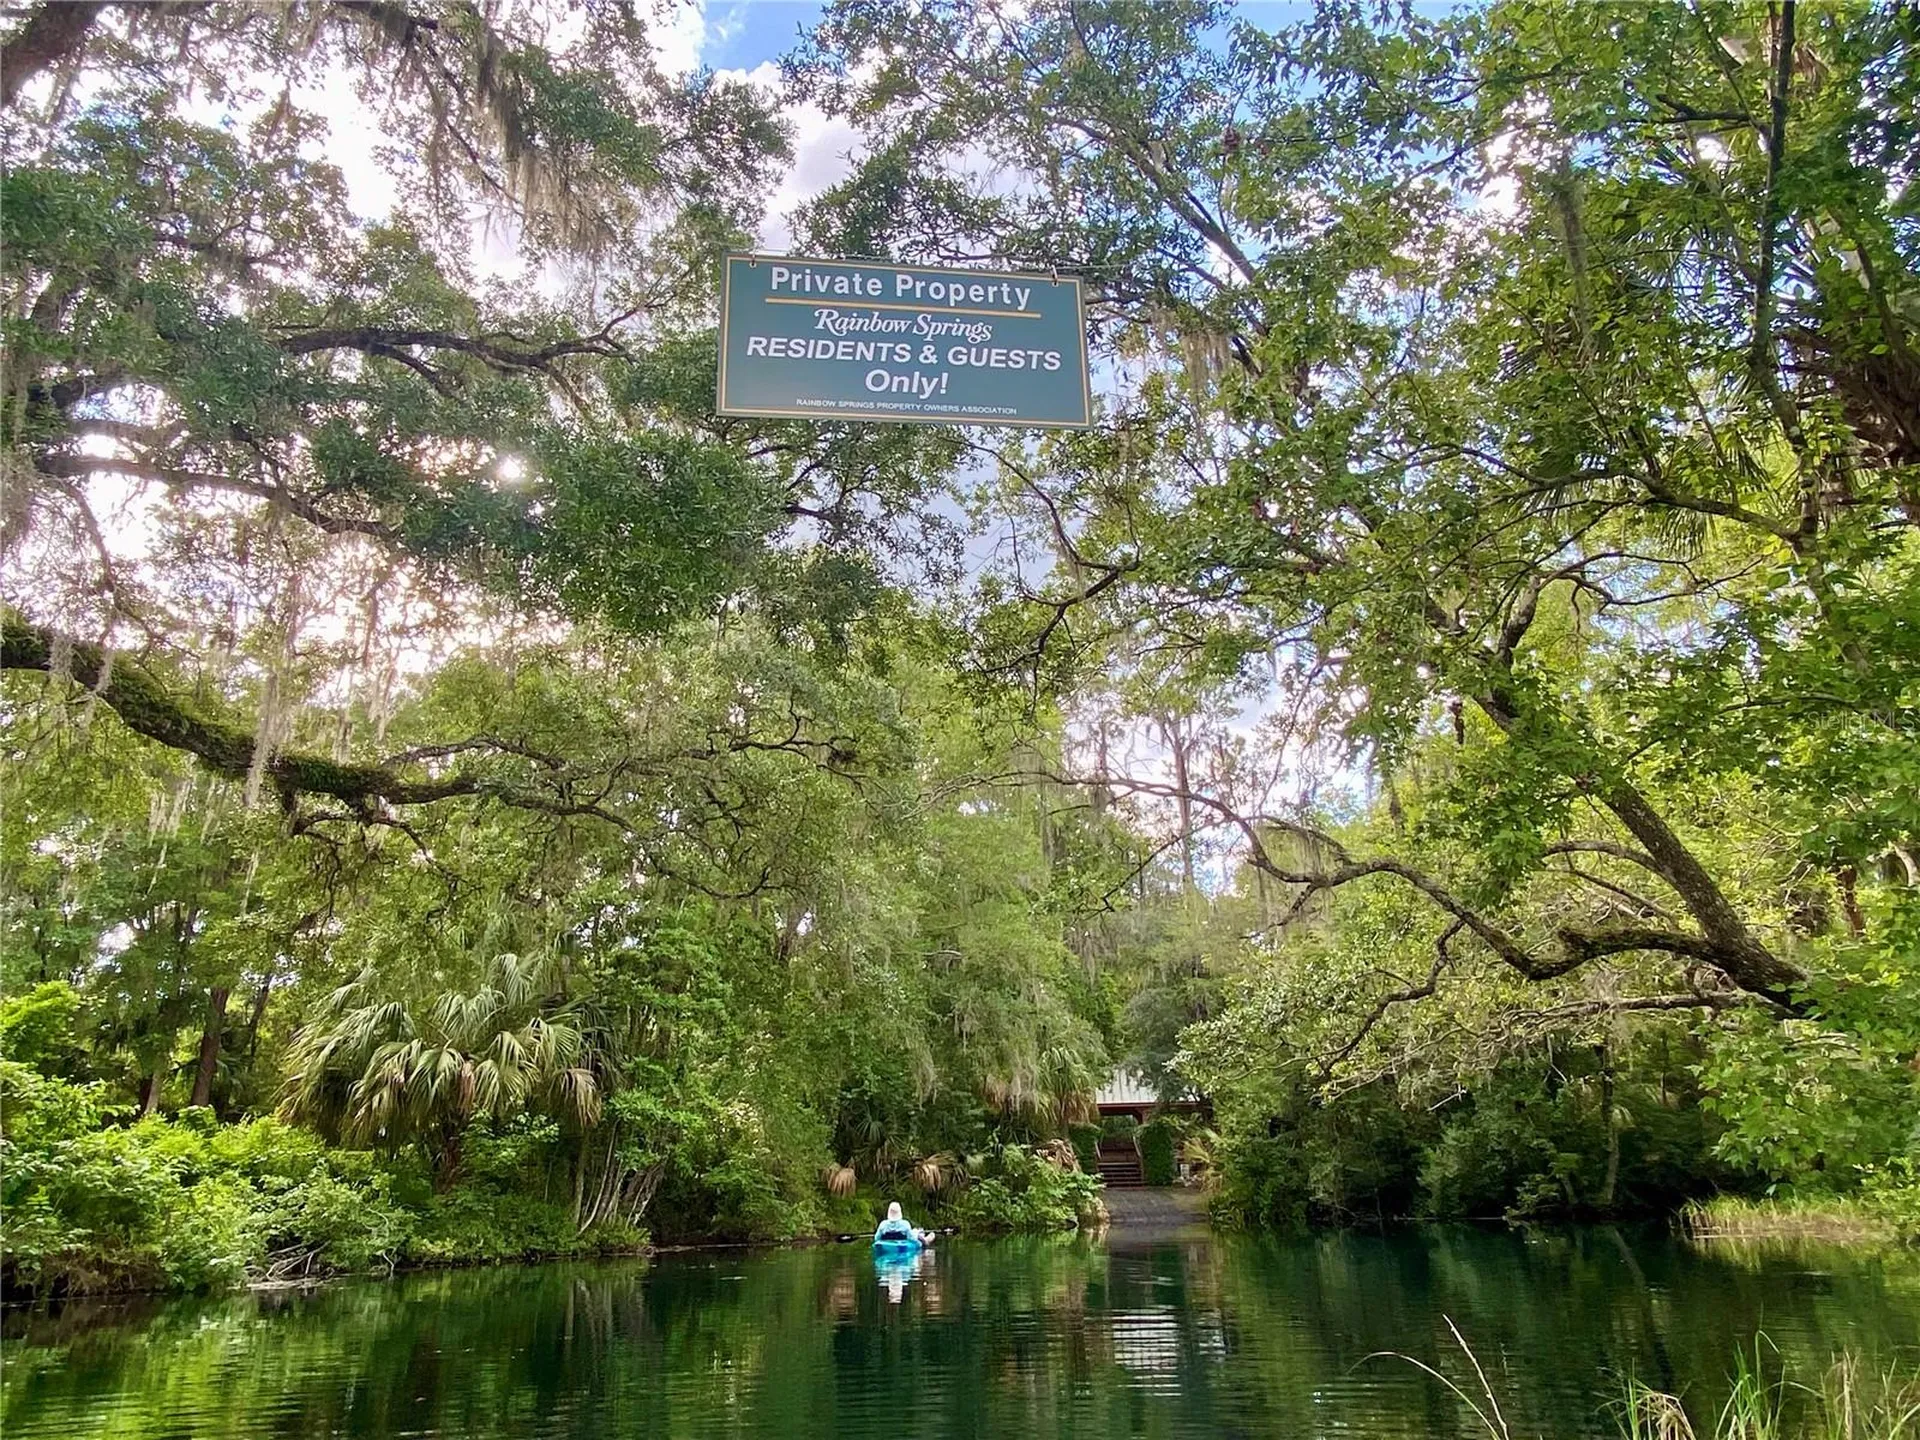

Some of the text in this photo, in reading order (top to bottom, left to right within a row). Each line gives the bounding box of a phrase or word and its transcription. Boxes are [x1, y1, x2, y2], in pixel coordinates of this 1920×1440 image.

[771, 267, 1031, 312] Private Property
[814, 309, 992, 344] Rainbow Springs
[747, 336, 1061, 371] RESIDENTS & GUESTS
[865, 369, 949, 400] Only!
[796, 399, 1017, 415] RAINBOW SPRINGS PROPERTY OWNERS ASSOCIATION
